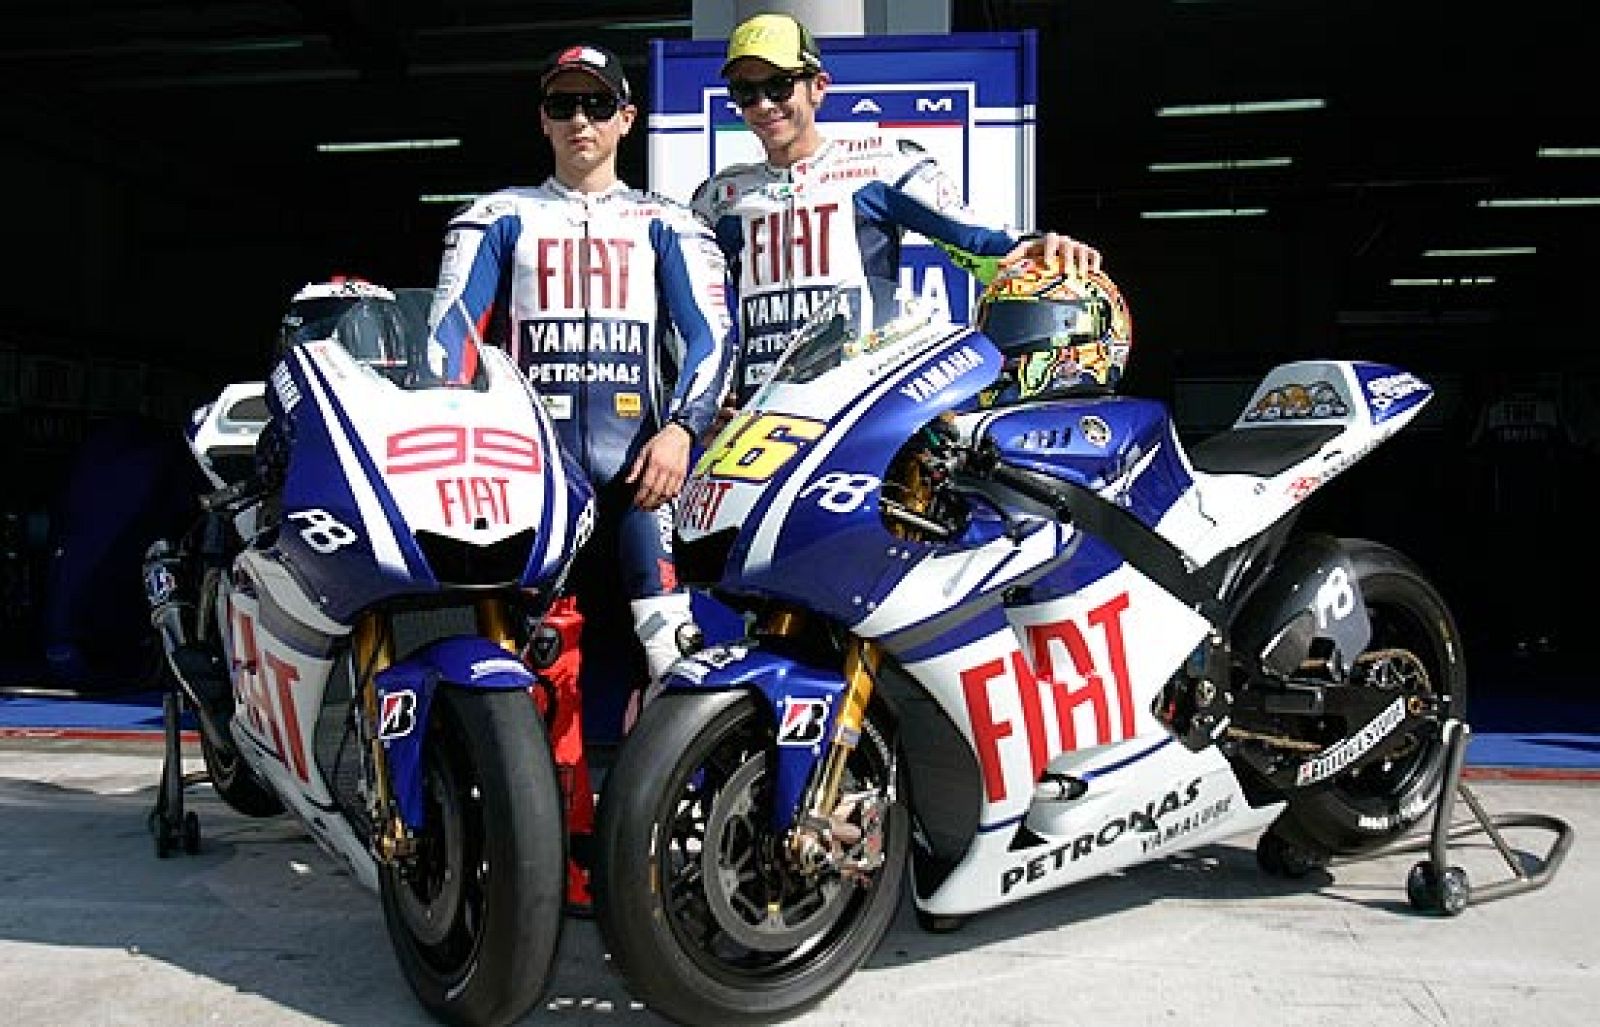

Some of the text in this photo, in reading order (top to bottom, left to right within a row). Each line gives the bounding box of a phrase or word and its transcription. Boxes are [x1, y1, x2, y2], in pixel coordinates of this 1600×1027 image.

[750, 203, 838, 286] FIAT
[537, 238, 635, 312] FIAT
[751, 289, 852, 327] YAMAHA
[527, 322, 642, 353] YAMAHA
[528, 362, 642, 385] PETRONAS
[899, 345, 985, 402] YAMAHA
[386, 424, 542, 476] 99
[436, 477, 510, 528] FIAT
[959, 591, 1138, 805] FIAT
[1000, 775, 1203, 896] PETRONAS
